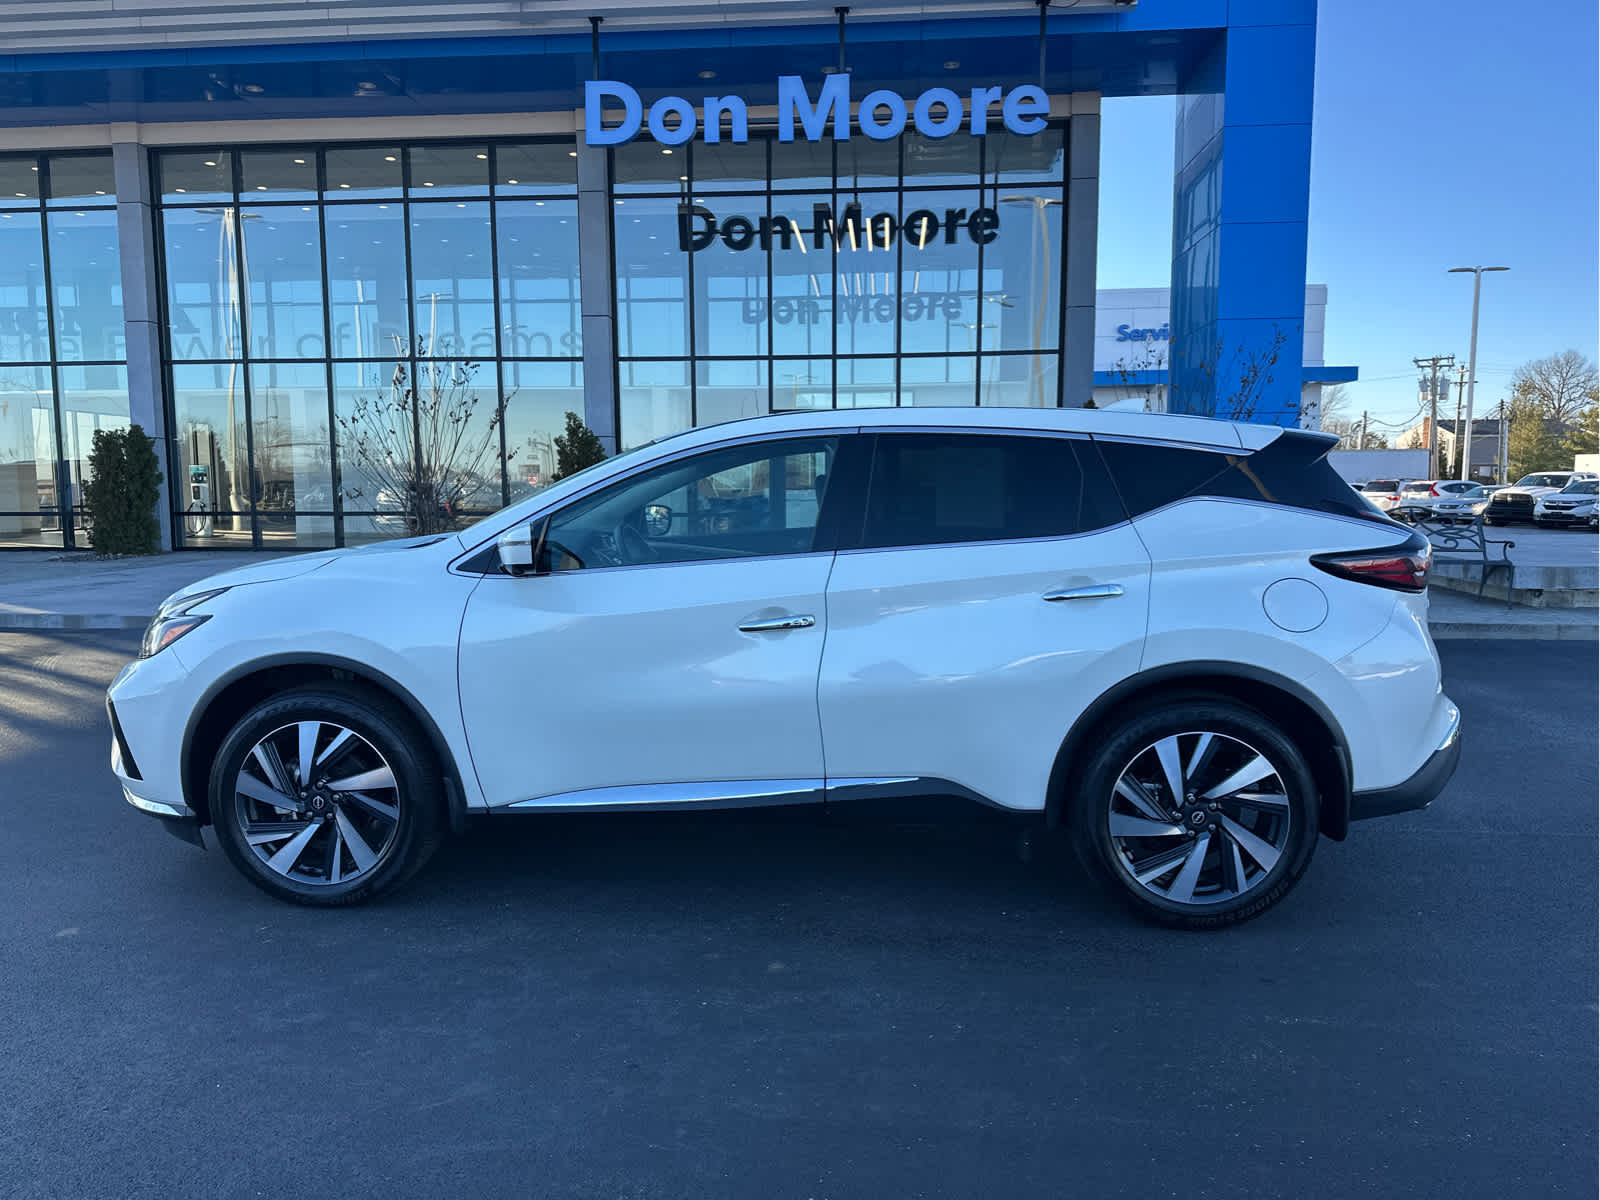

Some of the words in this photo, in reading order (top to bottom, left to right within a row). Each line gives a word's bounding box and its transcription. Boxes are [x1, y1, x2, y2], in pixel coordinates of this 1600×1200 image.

[585, 80, 749, 145] Don
[778, 73, 1050, 142] Moore
[677, 203, 793, 252] Don
[813, 203, 1000, 250] Moore
[836, 293, 962, 323] Moore
